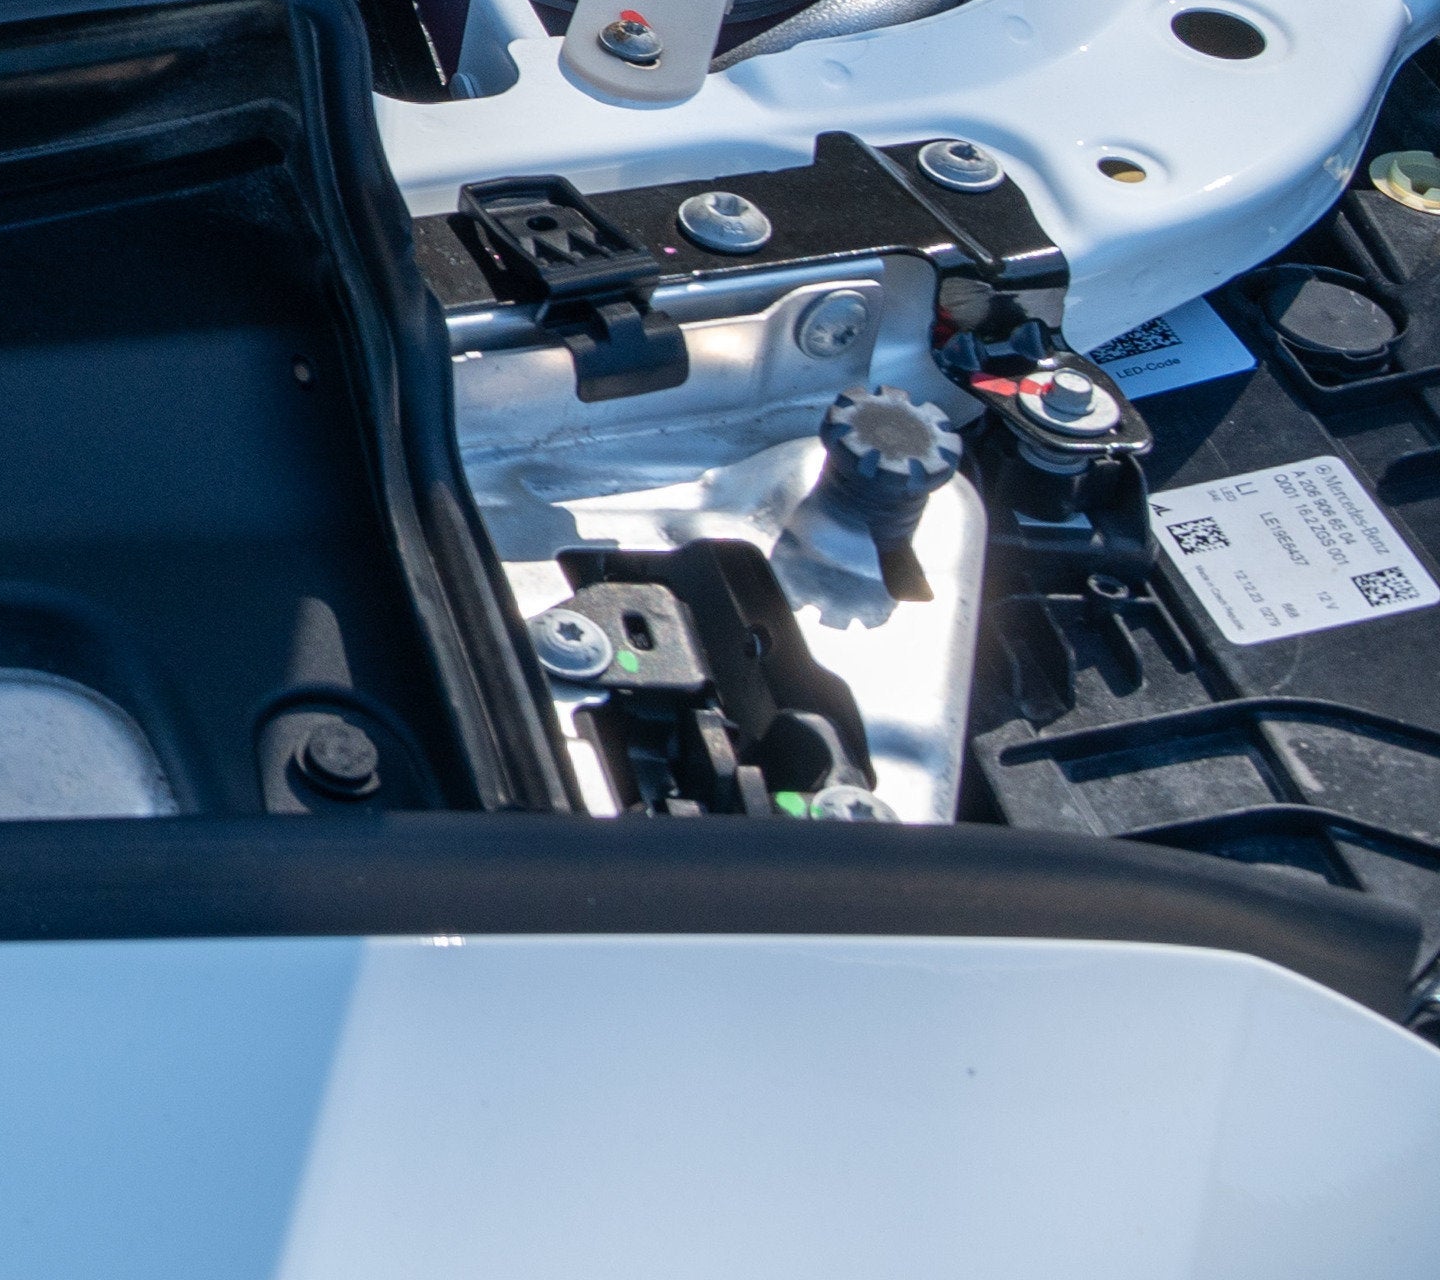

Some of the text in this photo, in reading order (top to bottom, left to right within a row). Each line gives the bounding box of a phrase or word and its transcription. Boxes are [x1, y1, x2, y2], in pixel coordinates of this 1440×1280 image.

[1116, 355, 1180, 380] LED-Code
[1292, 470, 1306, 478] A
[1234, 481, 1255, 499] LI
[1297, 478, 1322, 498] 206
[1312, 497, 1336, 517] 906
[1322, 474, 1389, 554] Mercedes-Benz
[1272, 473, 1300, 499] Q001
[1308, 523, 1336, 547] ZGS
[1326, 546, 1350, 565] 001
[1337, 531, 1357, 545] 04
[1316, 590, 1339, 611] 12 V
